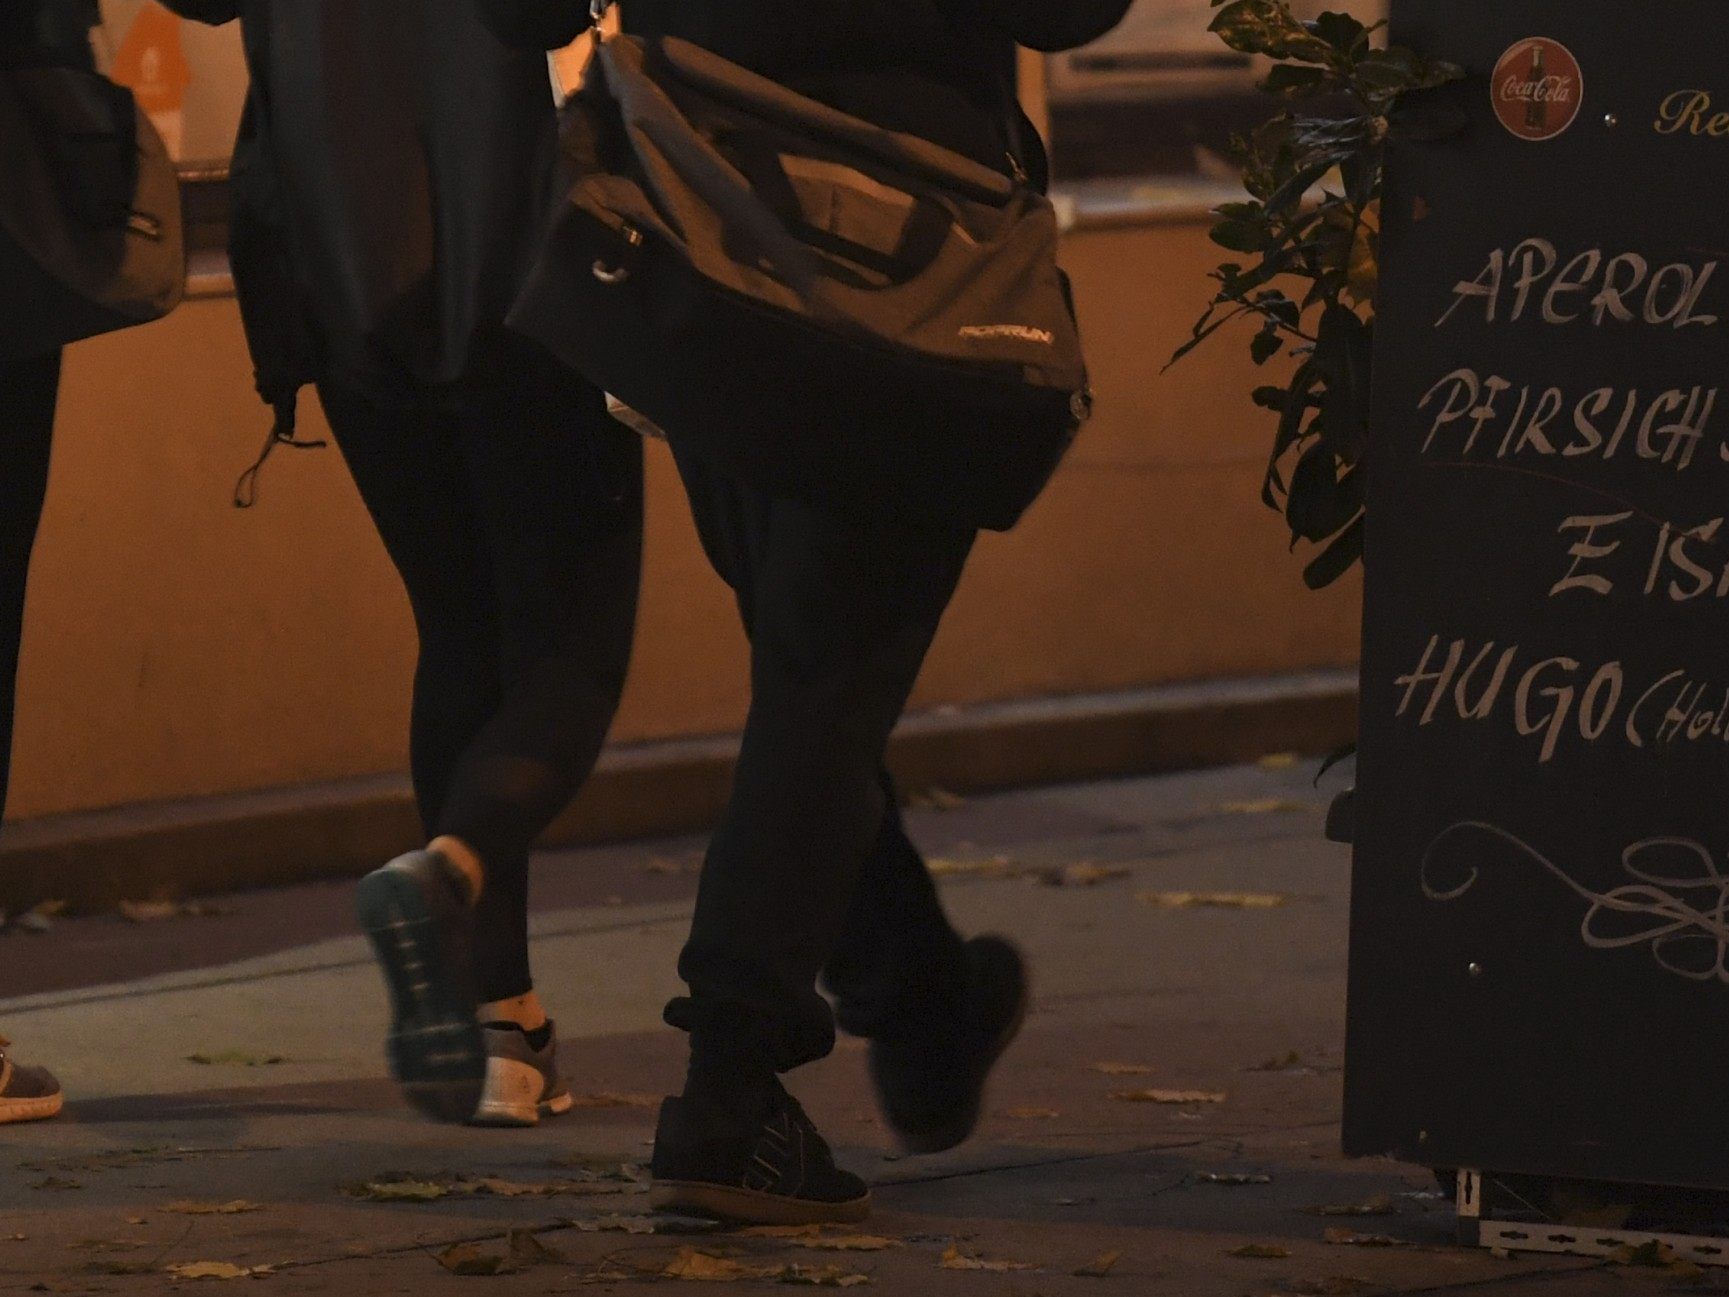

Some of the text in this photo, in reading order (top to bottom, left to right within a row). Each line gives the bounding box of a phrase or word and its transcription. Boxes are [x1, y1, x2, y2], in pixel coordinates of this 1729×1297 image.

[1500, 73, 1571, 103] Coca-Cola
[1435, 237, 1719, 329] APEROL
[1417, 367, 1718, 471] PFIRSICH
[1394, 633, 1623, 763] HUGO
